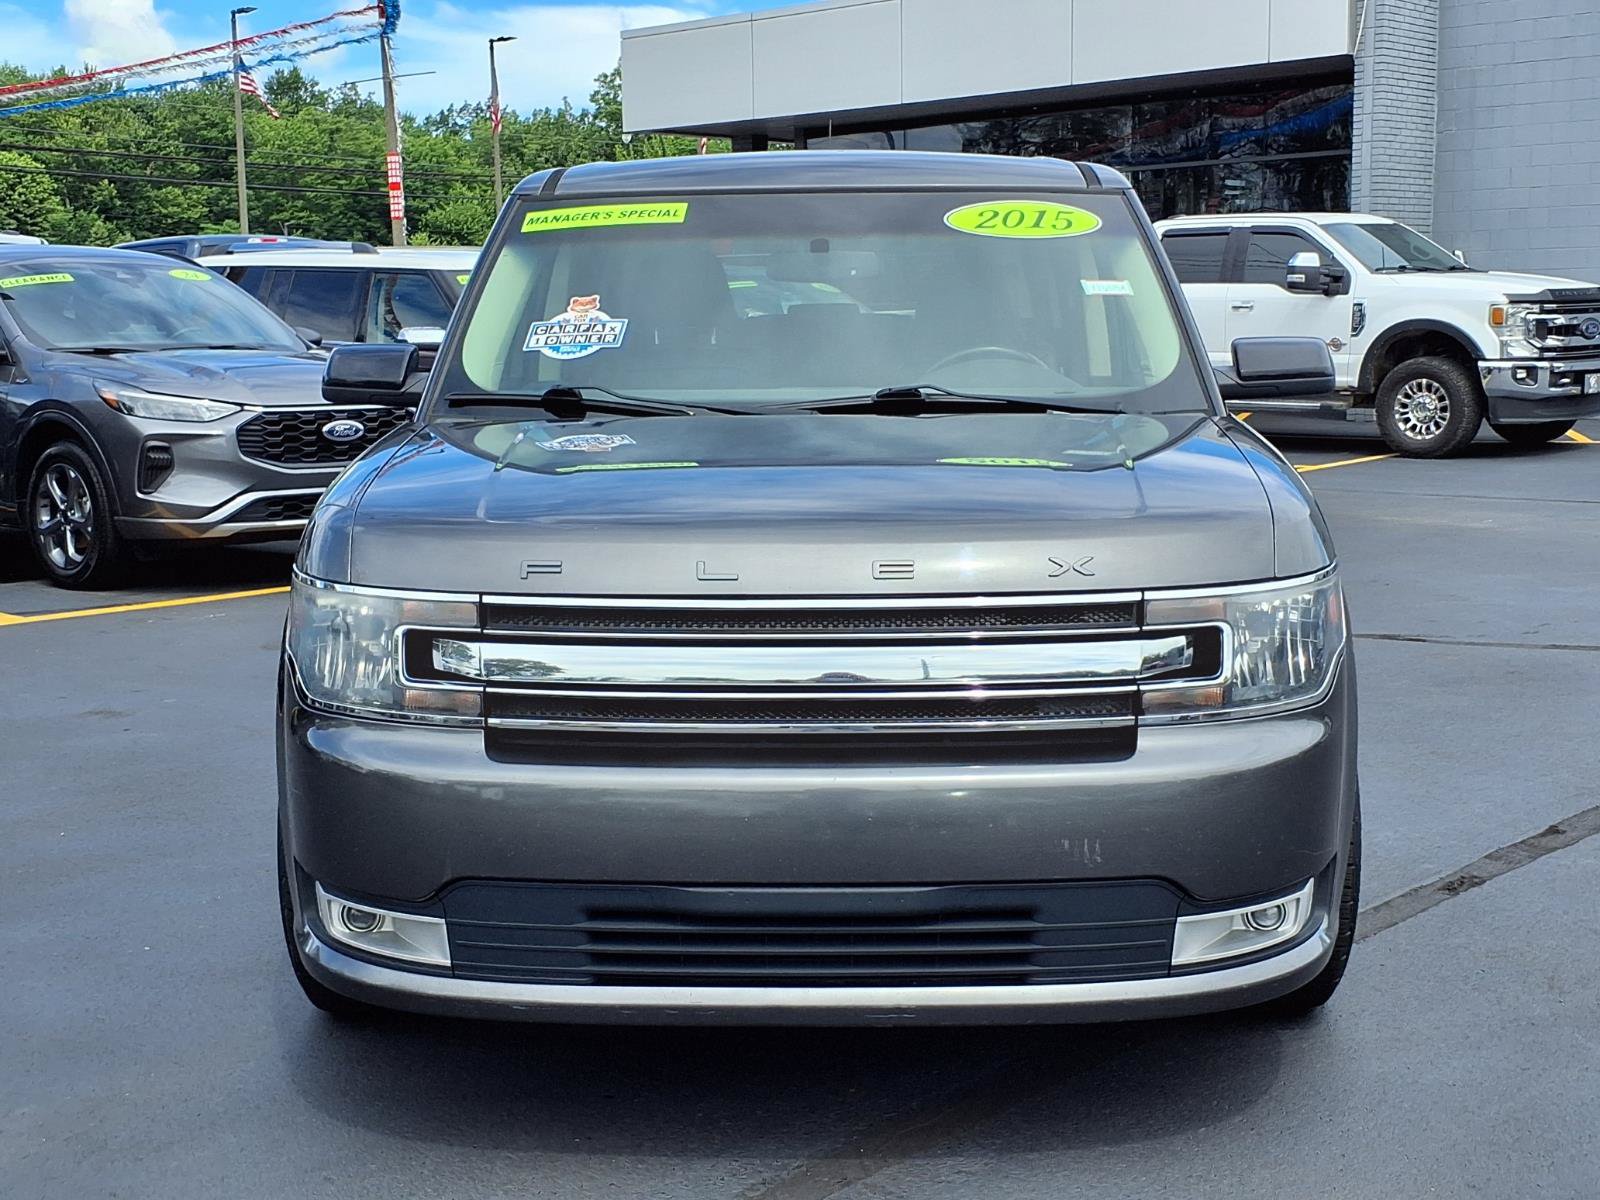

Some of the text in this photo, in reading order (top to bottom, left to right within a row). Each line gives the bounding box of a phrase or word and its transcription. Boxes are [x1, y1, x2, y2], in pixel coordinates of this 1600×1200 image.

[526, 208, 681, 226] MANAGER'S SPECIAL
[974, 209, 1075, 231] 2015
[1, 274, 70, 286] CLEARANCE
[535, 323, 617, 335] CARFAX
[545, 334, 618, 345] OWNER
